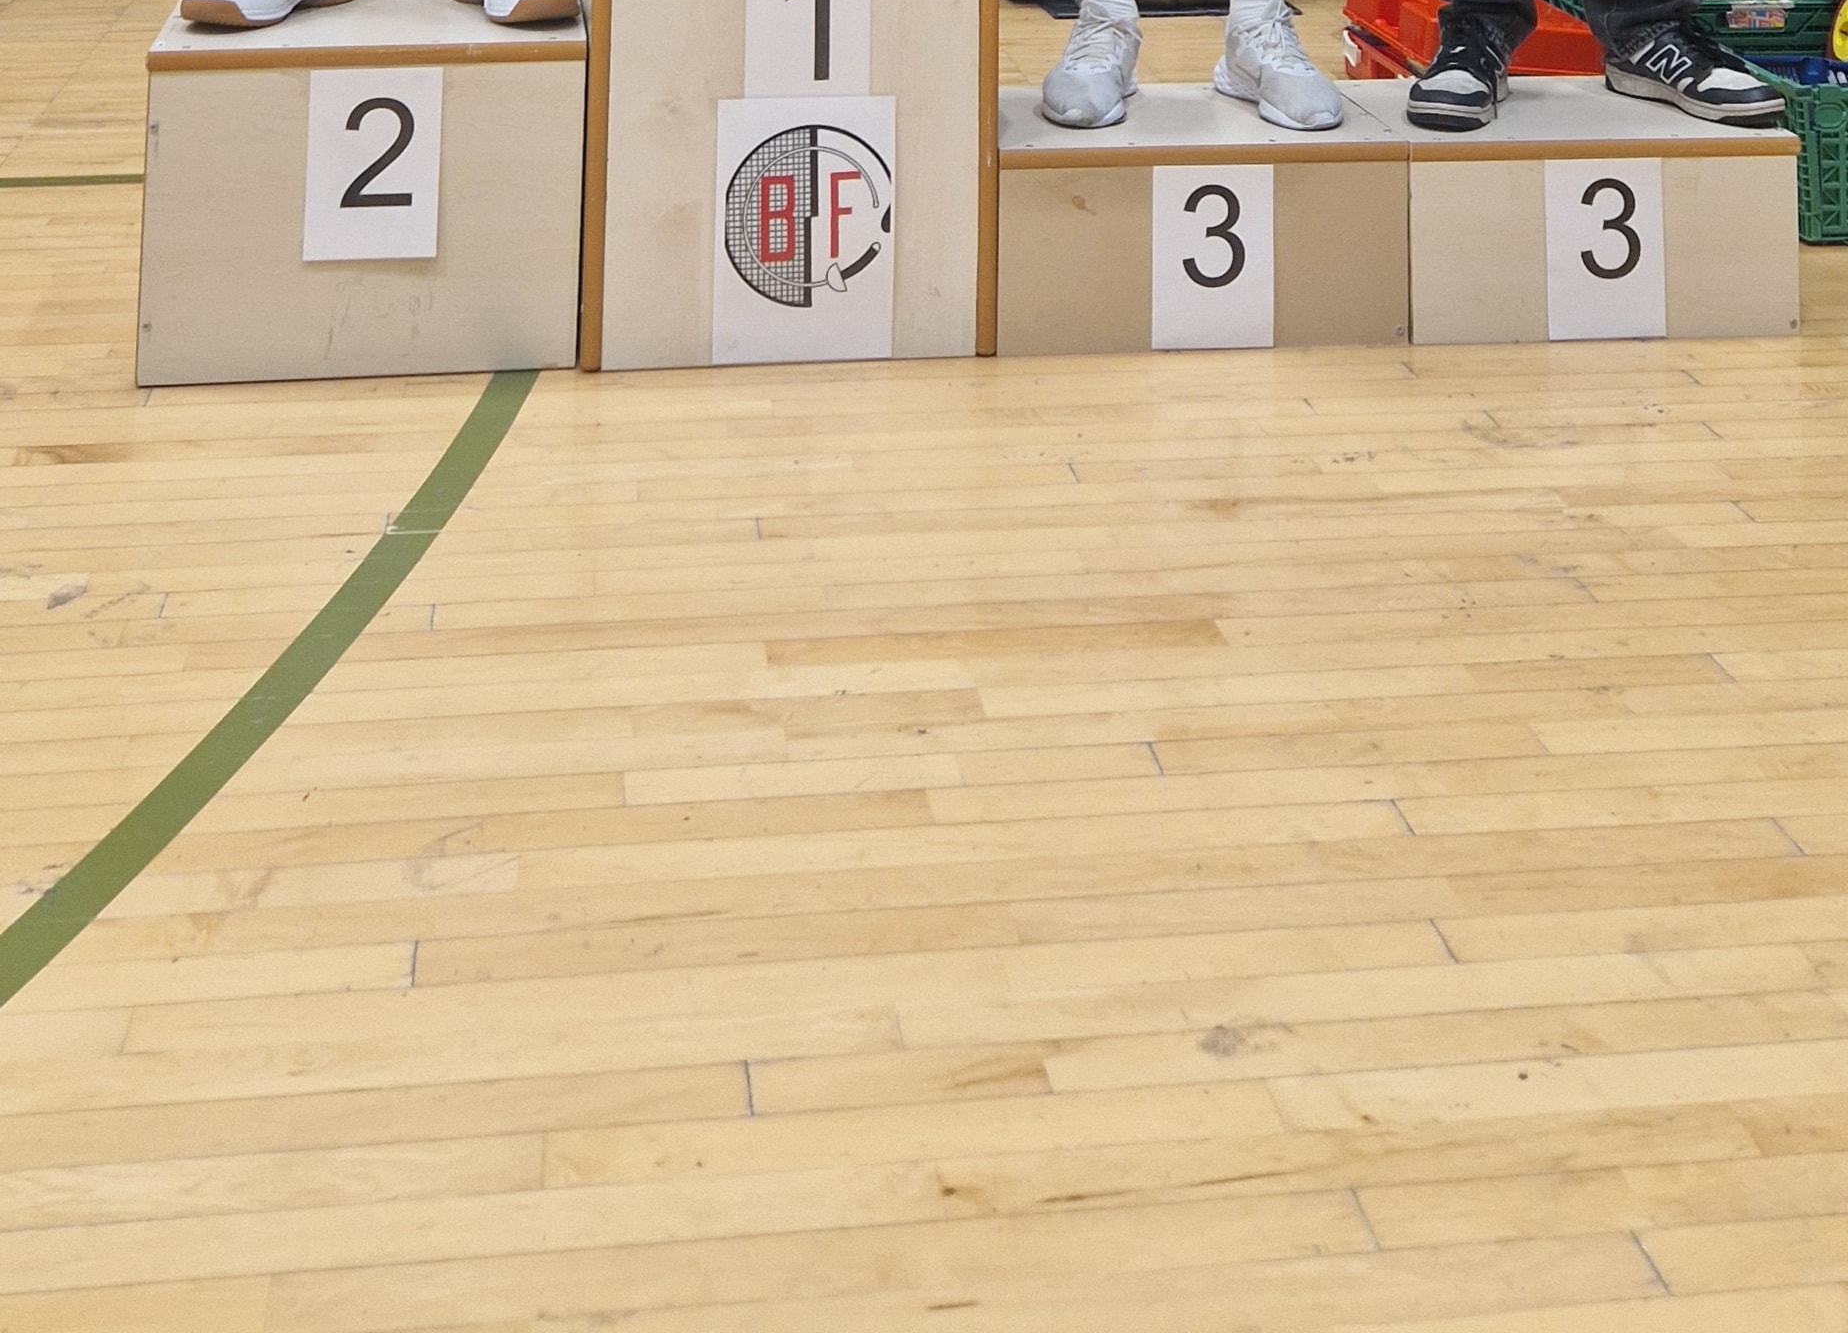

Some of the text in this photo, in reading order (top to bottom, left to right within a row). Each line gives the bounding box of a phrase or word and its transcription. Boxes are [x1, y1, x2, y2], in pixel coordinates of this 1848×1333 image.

[1646, 43, 1693, 84] N
[340, 97, 415, 208] 2
[1182, 184, 1245, 288] 3
[1580, 177, 1641, 279] 3
